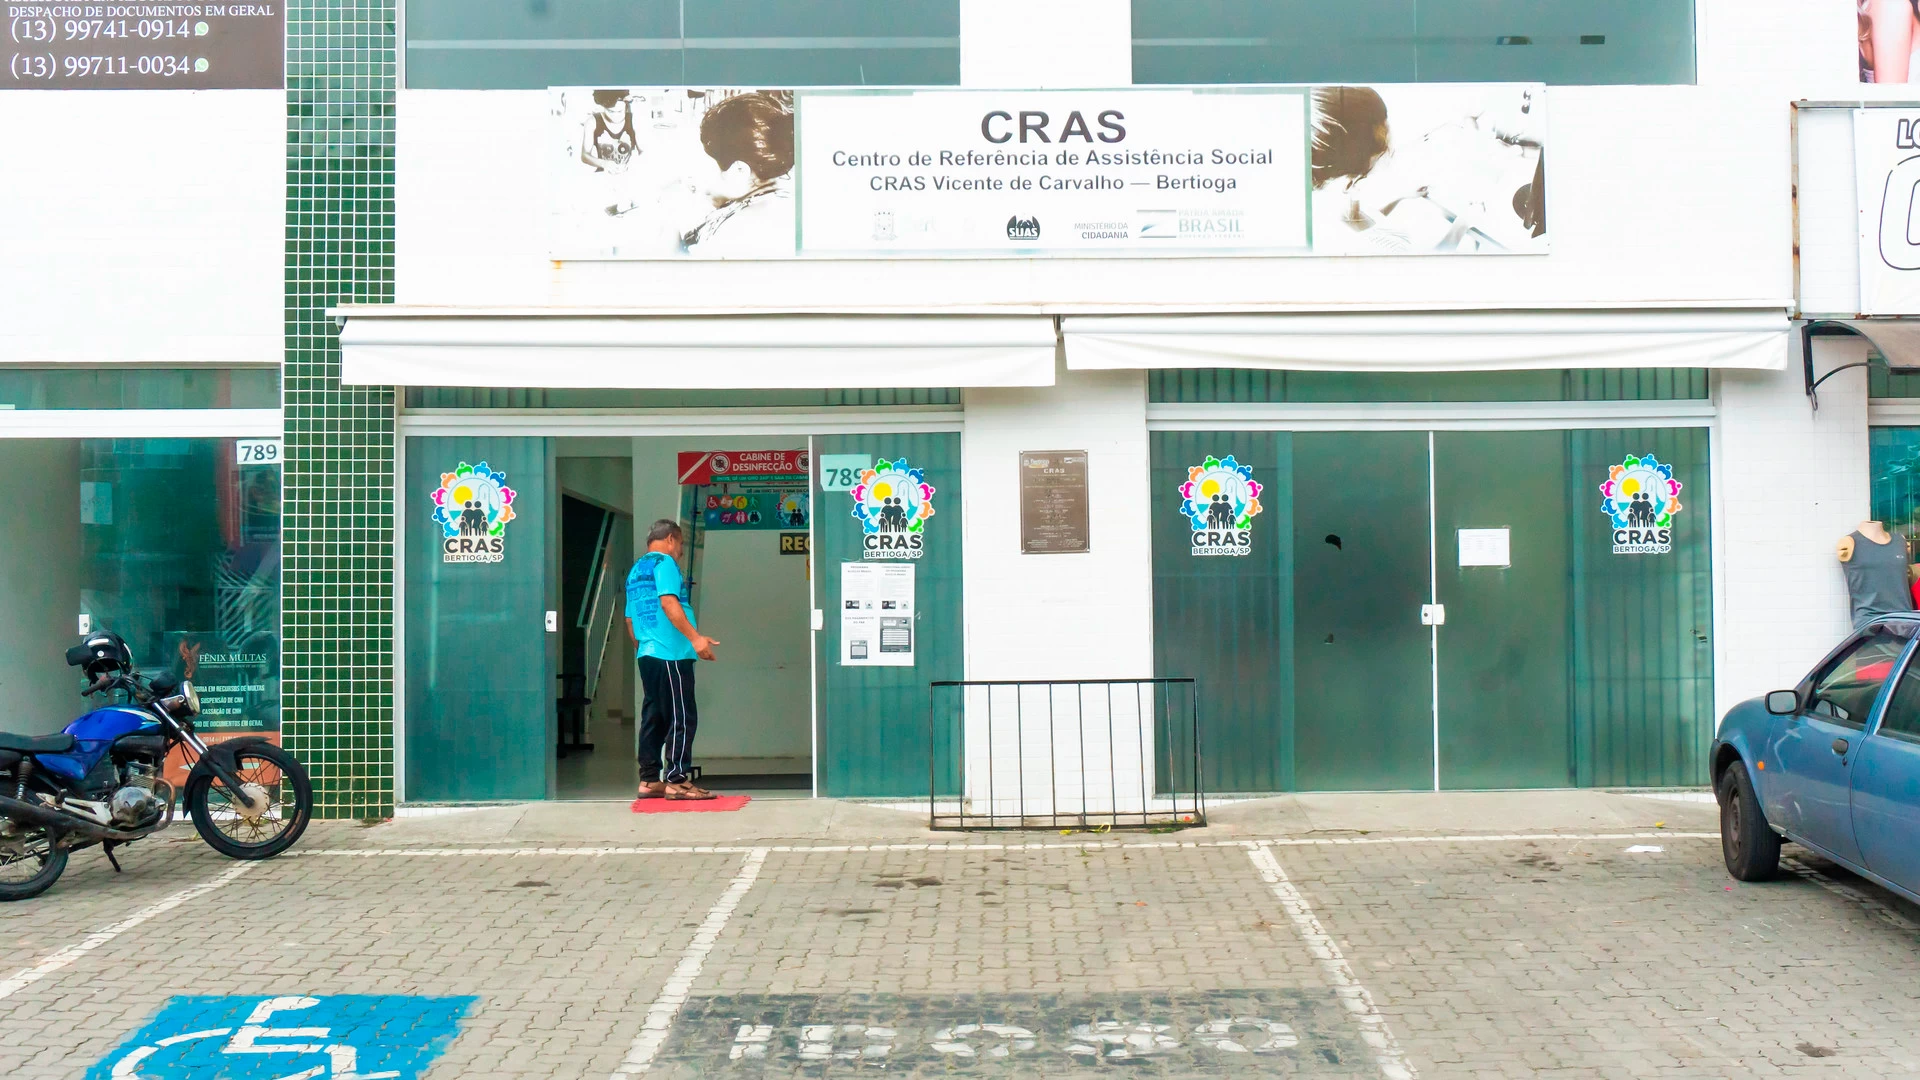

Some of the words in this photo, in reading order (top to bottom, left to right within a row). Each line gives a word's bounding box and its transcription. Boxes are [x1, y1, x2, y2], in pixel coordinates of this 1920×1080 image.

[9, 6, 82, 17] DESPACHO
[85, 6, 103, 17] DE
[106, 5, 202, 17] DOCUMENTOS
[205, 5, 226, 16] EM
[228, 5, 275, 16] GERAL
[11, 16, 57, 43] (13)
[64, 19, 190, 40] 99741-0914
[11, 53, 57, 79] (13)
[64, 56, 190, 77] 99711-0034
[981, 109, 1127, 144] CRAS
[832, 151, 901, 167] Centro
[908, 151, 932, 166] de
[939, 149, 1049, 166] Referência
[1055, 150, 1079, 165] de
[1086, 149, 1204, 165] Assistência
[1211, 149, 1273, 164] Social
[869, 176, 926, 191] CRAS
[932, 175, 1003, 191] Vicente
[1010, 175, 1033, 190] de
[1039, 174, 1124, 190] Carvalho
[1156, 174, 1237, 193] Bertioga
[1008, 227, 1038, 237] SUAS
[1118, 222, 1129, 230] DA
[1178, 218, 1244, 232] BRASIL
[241, 444, 277, 461] 789
[740, 453, 771, 461] CABINE
[733, 462, 793, 472] DESINFECÇÃO
[865, 535, 922, 549] CRAS
[1193, 532, 1250, 546] CRAS
[1614, 530, 1670, 544] CRAS
[445, 539, 503, 553] CRAS
[199, 653, 226, 662] FÊNIX
[229, 653, 267, 661] MULTAS
